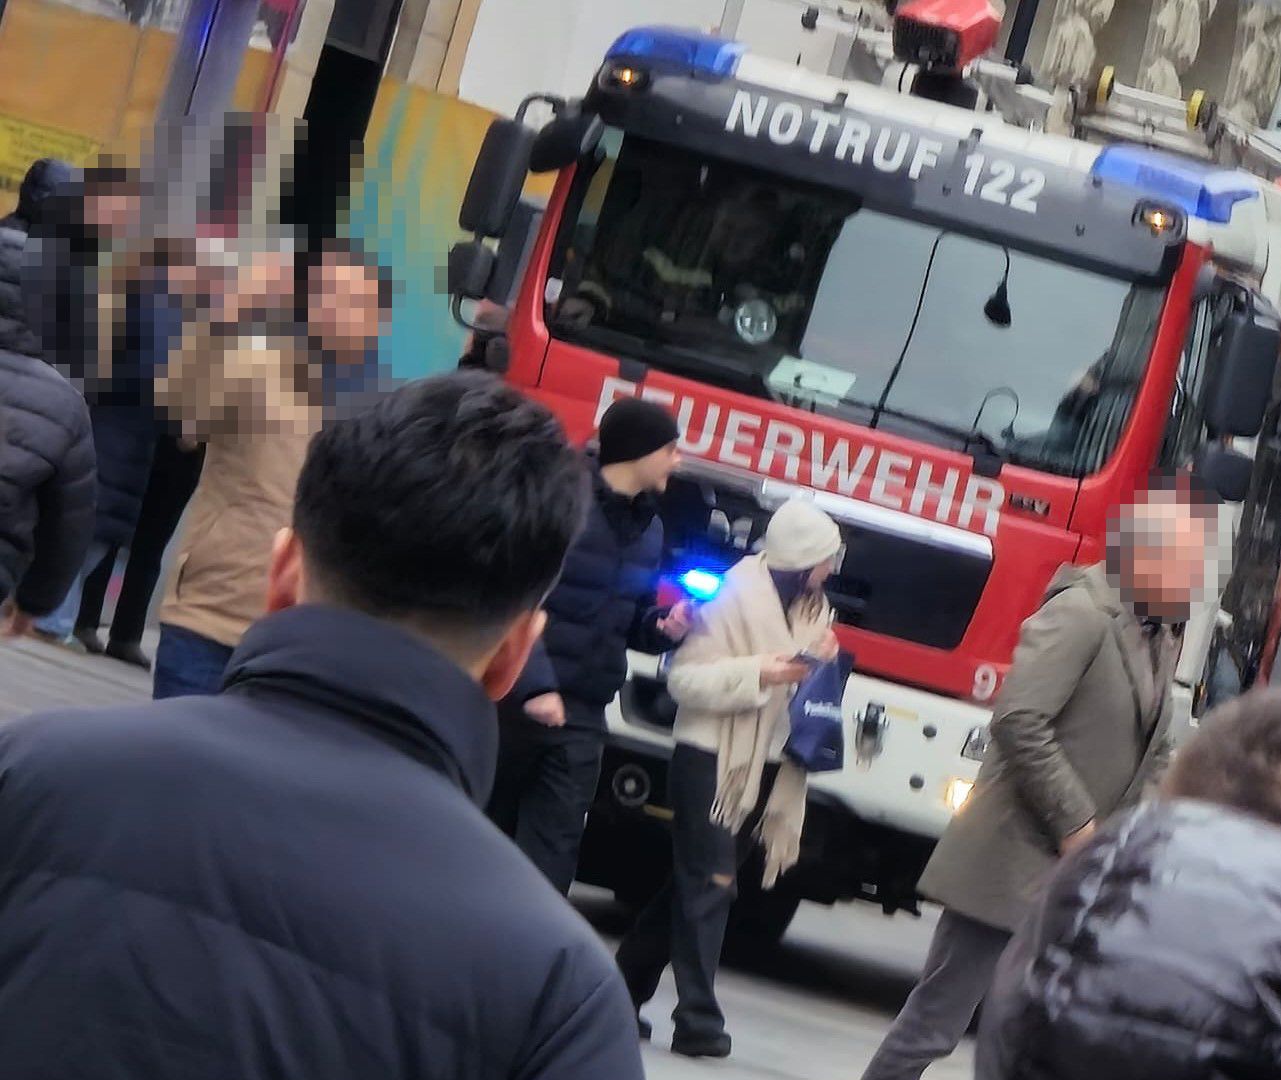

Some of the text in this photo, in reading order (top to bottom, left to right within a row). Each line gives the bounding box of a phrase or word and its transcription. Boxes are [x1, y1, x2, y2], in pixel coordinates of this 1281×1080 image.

[724, 89, 1046, 214] NOTRUF 122
[971, 663, 998, 701] 9
